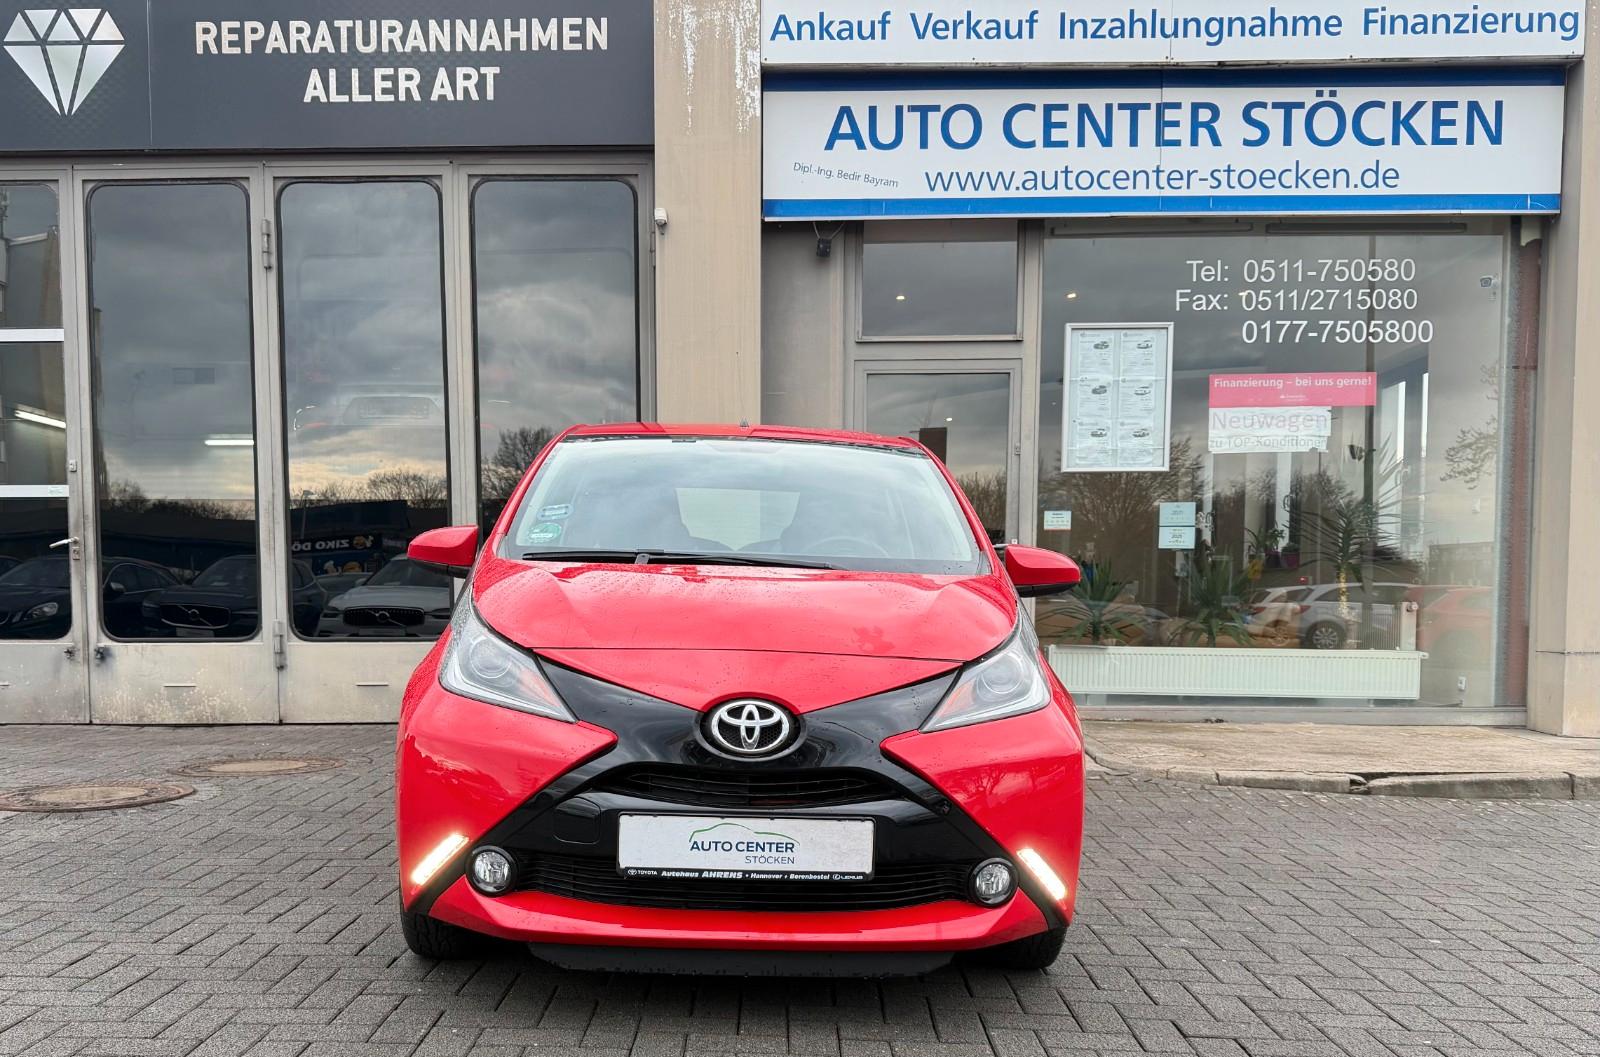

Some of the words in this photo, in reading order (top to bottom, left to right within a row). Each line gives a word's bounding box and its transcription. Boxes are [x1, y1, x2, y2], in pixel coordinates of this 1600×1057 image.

[195, 17, 608, 54] REPARATURANNAHMEN
[770, 11, 891, 41] Ankauf
[910, 10, 1039, 40] Verkauf
[1060, 8, 1342, 46] Inzahlungnahme
[1364, 5, 1579, 40] Finanzierung
[303, 68, 421, 102] ALLER
[430, 66, 500, 101] ART
[824, 103, 983, 151] AUTO
[1002, 101, 1223, 150] CENTER
[1242, 90, 1504, 148] STÖCKEN
[793, 162, 834, 179] Dipl.-Ing.
[837, 169, 861, 182] Bedir
[863, 173, 899, 188] Bayram
[925, 159, 1400, 192] www.autocenter-stoecken.de
[1186, 260, 1229, 282] Tel:
[1243, 259, 1416, 282] 0511-750580
[1175, 289, 1229, 311] Fax:
[1241, 288, 1418, 311] 0511/2715080
[1242, 320, 1434, 344] 0177-7505800
[1214, 378, 1283, 389] Finanzierung
[1295, 377, 1312, 386] bei
[1315, 377, 1333, 386] uns
[1337, 376, 1372, 388] gerne!
[1212, 412, 1327, 432] Neuwagen
[690, 840, 733, 852] AUTO
[735, 841, 795, 853] CENTER
[744, 855, 795, 865] STÖCKEN
[661, 870, 699, 878] Autohaus
[701, 871, 743, 879] AHRENS
